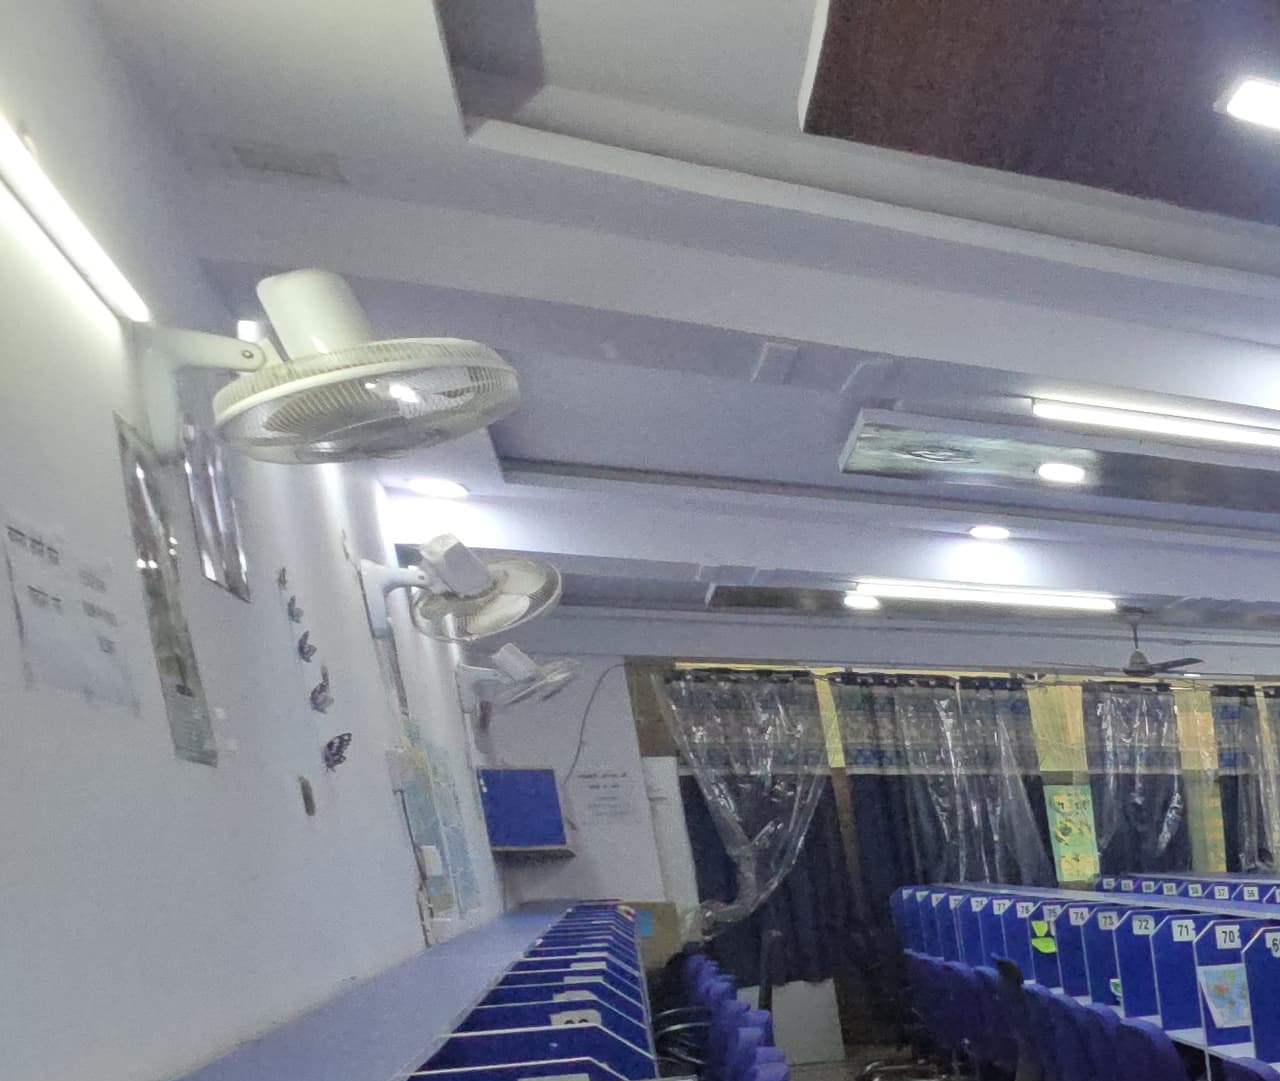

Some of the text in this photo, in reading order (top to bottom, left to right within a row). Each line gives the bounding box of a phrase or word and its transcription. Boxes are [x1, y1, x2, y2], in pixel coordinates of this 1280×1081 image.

[1073, 911, 1084, 921] 74
[1102, 915, 1114, 926] 73
[1137, 919, 1149, 930] 72
[1177, 924, 1189, 937] 71
[1222, 930, 1235, 944] 70
